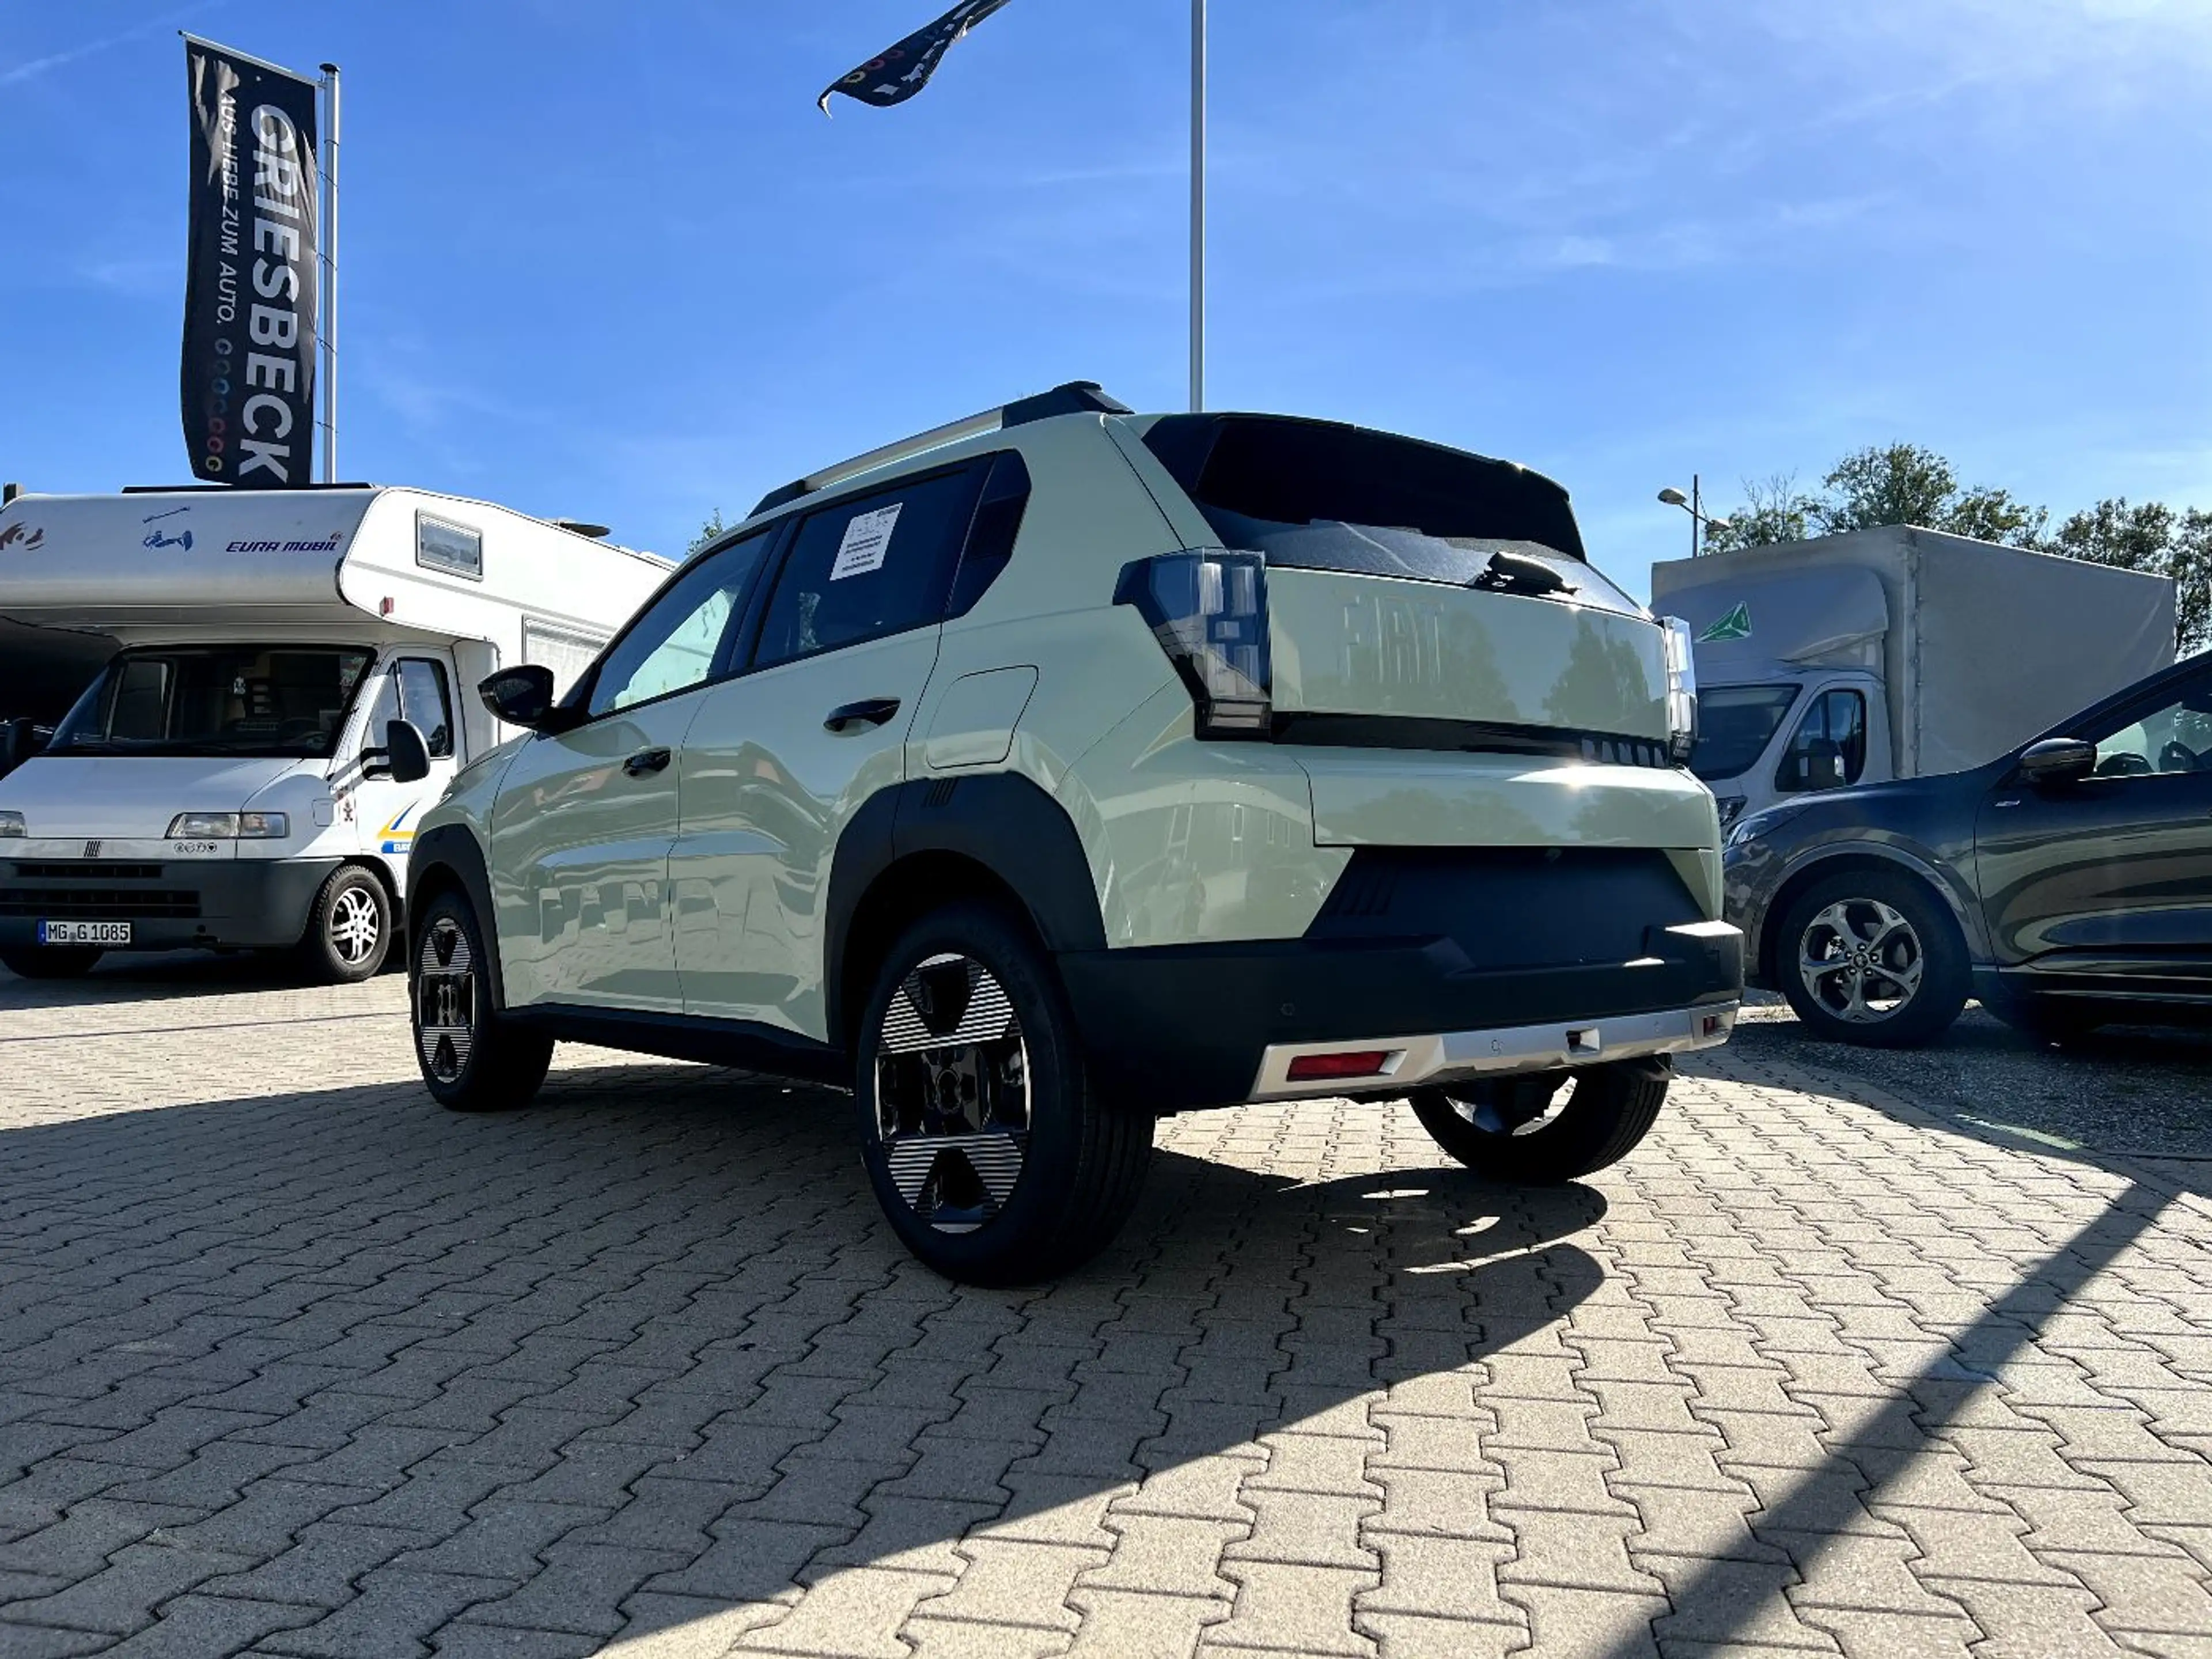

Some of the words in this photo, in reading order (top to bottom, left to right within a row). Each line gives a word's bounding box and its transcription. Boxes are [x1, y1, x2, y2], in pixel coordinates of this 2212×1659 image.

[221, 89, 237, 135] AUS
[222, 141, 238, 200] LIEBE
[221, 205, 239, 255] ZUM
[217, 260, 237, 324] AUTO.
[238, 104, 300, 485] GRIESBECK
[226, 541, 281, 552] EURA
[1335, 594, 1444, 683] FIAT
[48, 924, 67, 940] MG
[77, 924, 87, 940] G
[90, 924, 128, 941] 1085
